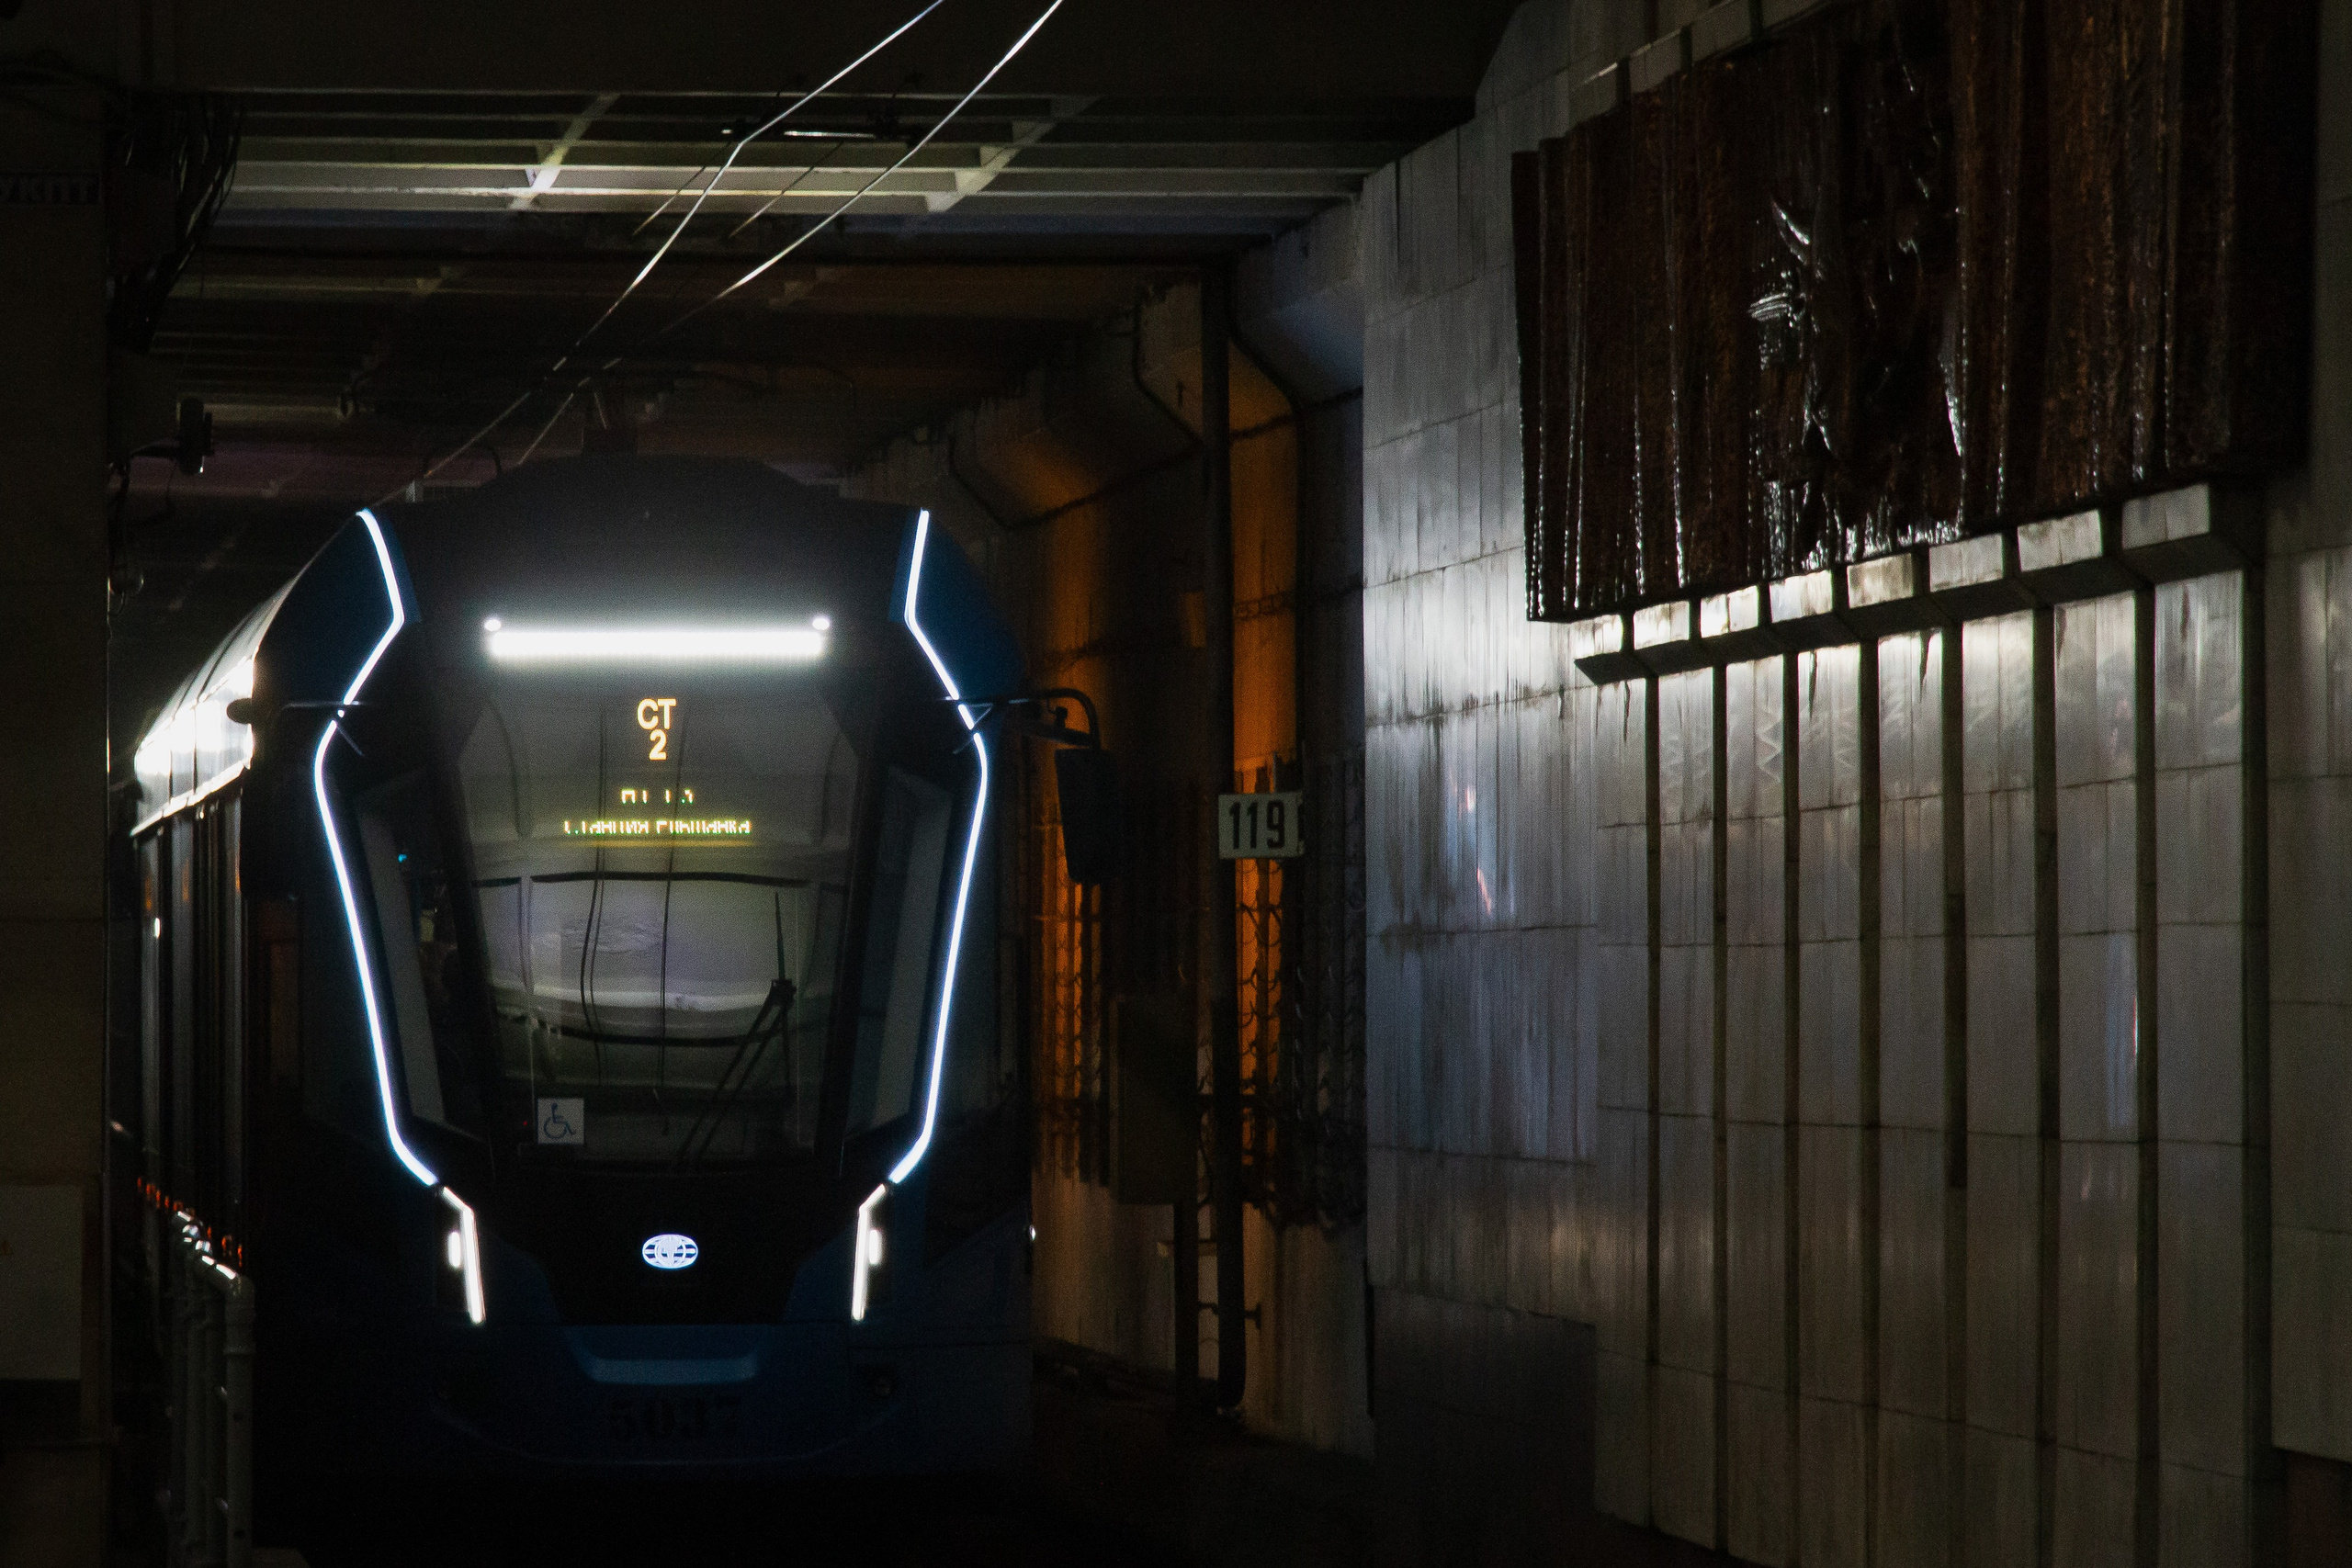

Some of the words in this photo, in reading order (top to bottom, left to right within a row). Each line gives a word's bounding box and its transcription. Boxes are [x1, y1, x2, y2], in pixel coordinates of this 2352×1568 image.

[637, 698, 676, 729] СТ
[649, 729, 667, 761] 2
[1229, 800, 1285, 850] 119
